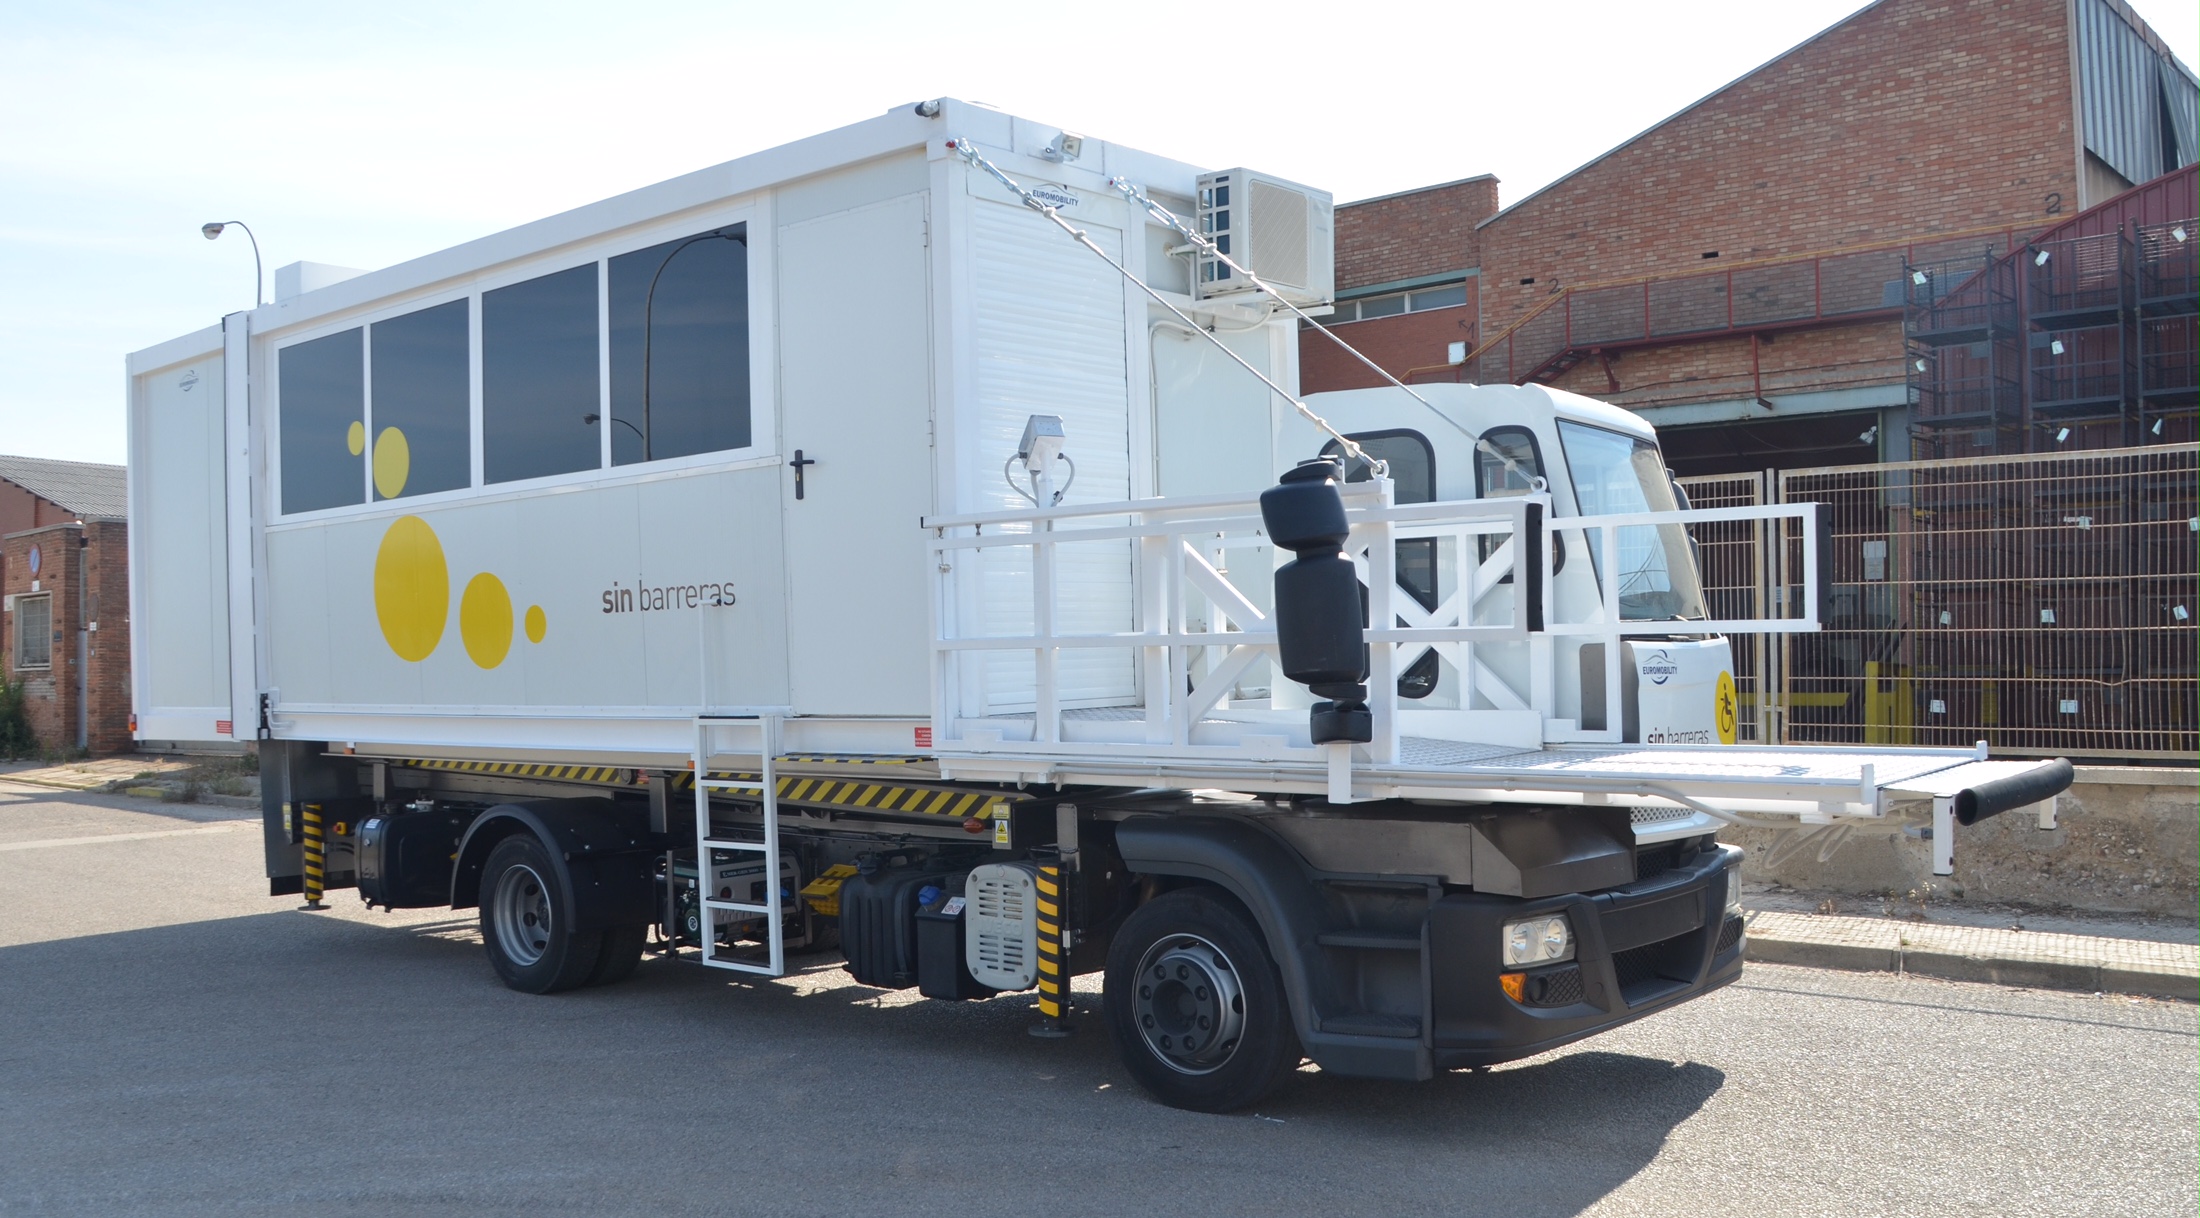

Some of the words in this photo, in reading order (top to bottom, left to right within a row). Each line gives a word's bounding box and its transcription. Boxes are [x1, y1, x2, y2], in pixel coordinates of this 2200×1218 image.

[1032, 189, 1079, 207] EUROMOBILITY
[2044, 192, 2061, 214] 2
[602, 581, 633, 614] sin
[638, 579, 736, 612] barreras
[1642, 666, 1678, 675] EUROMOBILITY
